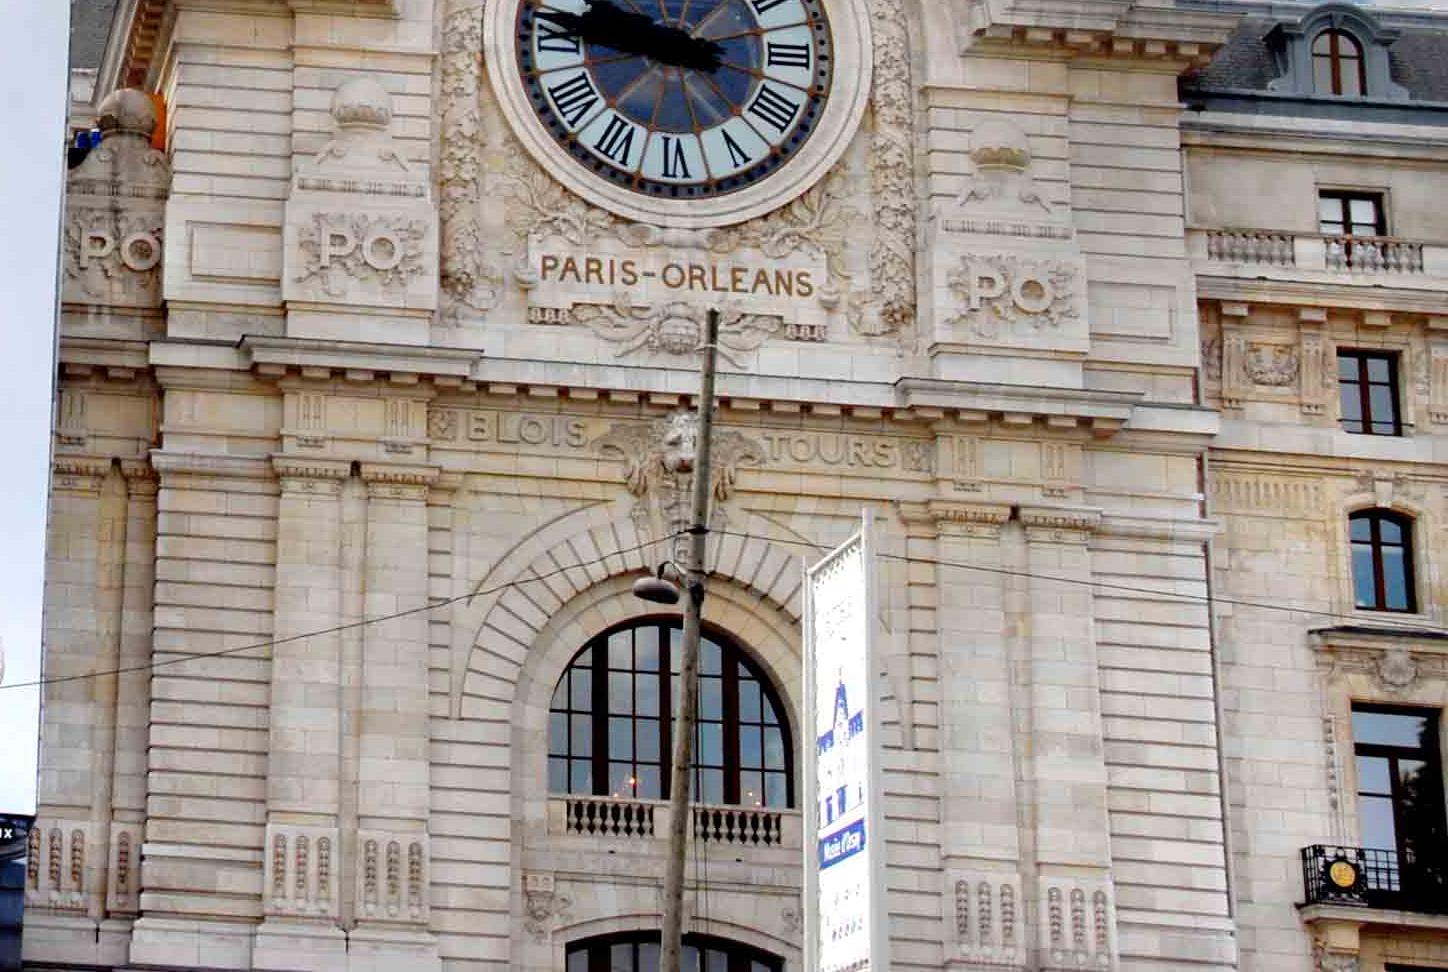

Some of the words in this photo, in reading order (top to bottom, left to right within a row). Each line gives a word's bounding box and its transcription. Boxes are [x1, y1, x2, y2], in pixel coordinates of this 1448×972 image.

[767, 42, 810, 70] III
[548, 72, 600, 127] VIII
[748, 84, 801, 134] IIII
[593, 114, 636, 166] VII
[661, 136, 691, 178] VI
[721, 129, 752, 168] V
[319, 226, 404, 271] PO
[540, 255, 814, 298] PARIS-ORLEANS
[968, 268, 1054, 315] PO
[464, 412, 587, 448] BLOIS
[763, 434, 890, 468] TOURS
